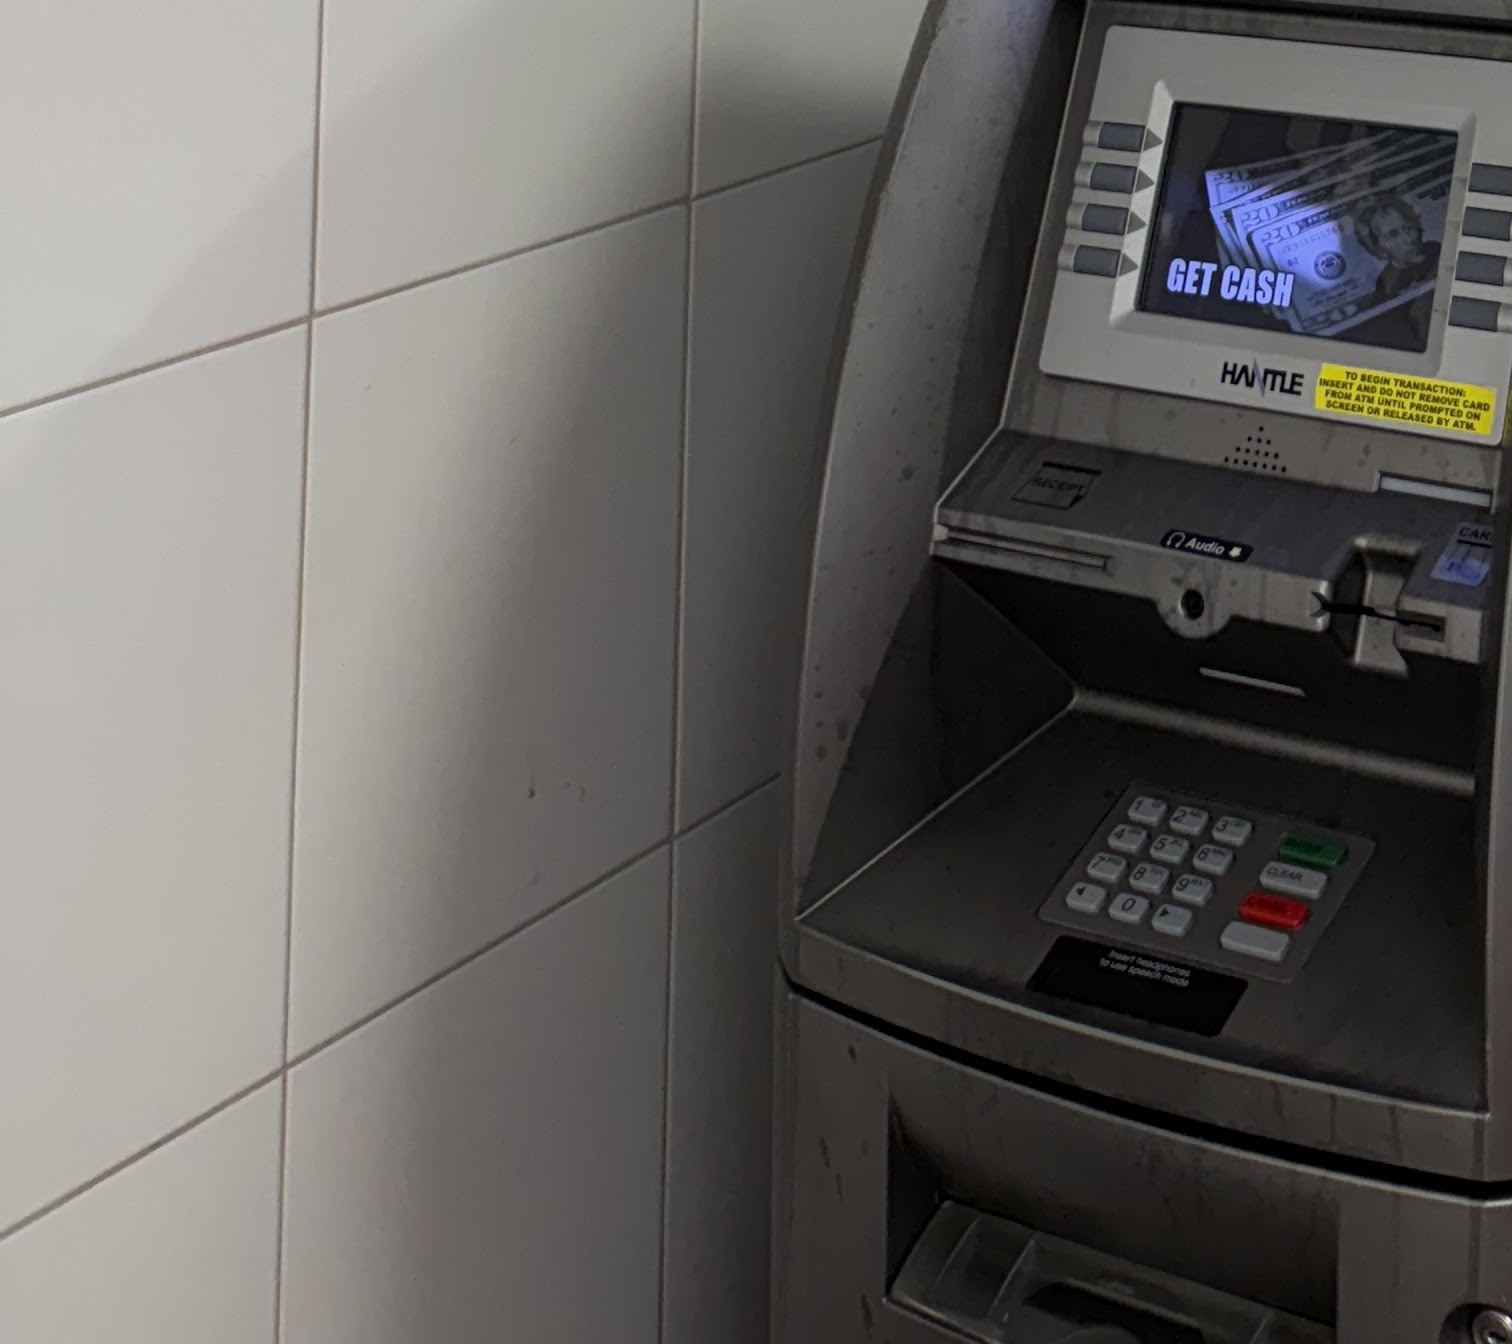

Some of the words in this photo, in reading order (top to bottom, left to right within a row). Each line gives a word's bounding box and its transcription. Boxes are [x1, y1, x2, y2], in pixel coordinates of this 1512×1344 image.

[1166, 257, 1218, 297] GET
[1219, 264, 1296, 308] CASH
[1220, 358, 1305, 398] HANTLE
[1345, 370, 1357, 381] TO
[1359, 373, 1391, 386] BEGIN
[1318, 377, 1354, 391] INSERT
[1356, 382, 1377, 394] AND
[1379, 386, 1393, 397] DO
[1395, 388, 1417, 400] NOT
[1418, 391, 1460, 407] REMOVE
[1462, 398, 1491, 412] CARD
[1324, 389, 1352, 401] FROM
[1353, 393, 1375, 405] ATM
[1377, 395, 1407, 410] UNTIL
[1409, 401, 1463, 419] PROMPTED
[1465, 410, 1481, 421] ON
[1325, 399, 1365, 415] SCREEN
[1366, 405, 1381, 416] OR
[1383, 408, 1434, 425] RELEASED
[1436, 416, 1451, 427] BY
[1031, 476, 1086, 492] RECEIPT
[1185, 536, 1226, 556] Audio
[1133, 798, 1144, 810] 1
[1173, 809, 1187, 822] 2
[1215, 820, 1229, 832] 3
[1114, 828, 1125, 840] 4
[1153, 837, 1169, 850] 5
[1197, 847, 1210, 860] 6
[1091, 856, 1105, 869] 7
[1133, 867, 1146, 880] 8
[1175, 878, 1190, 891] 9
